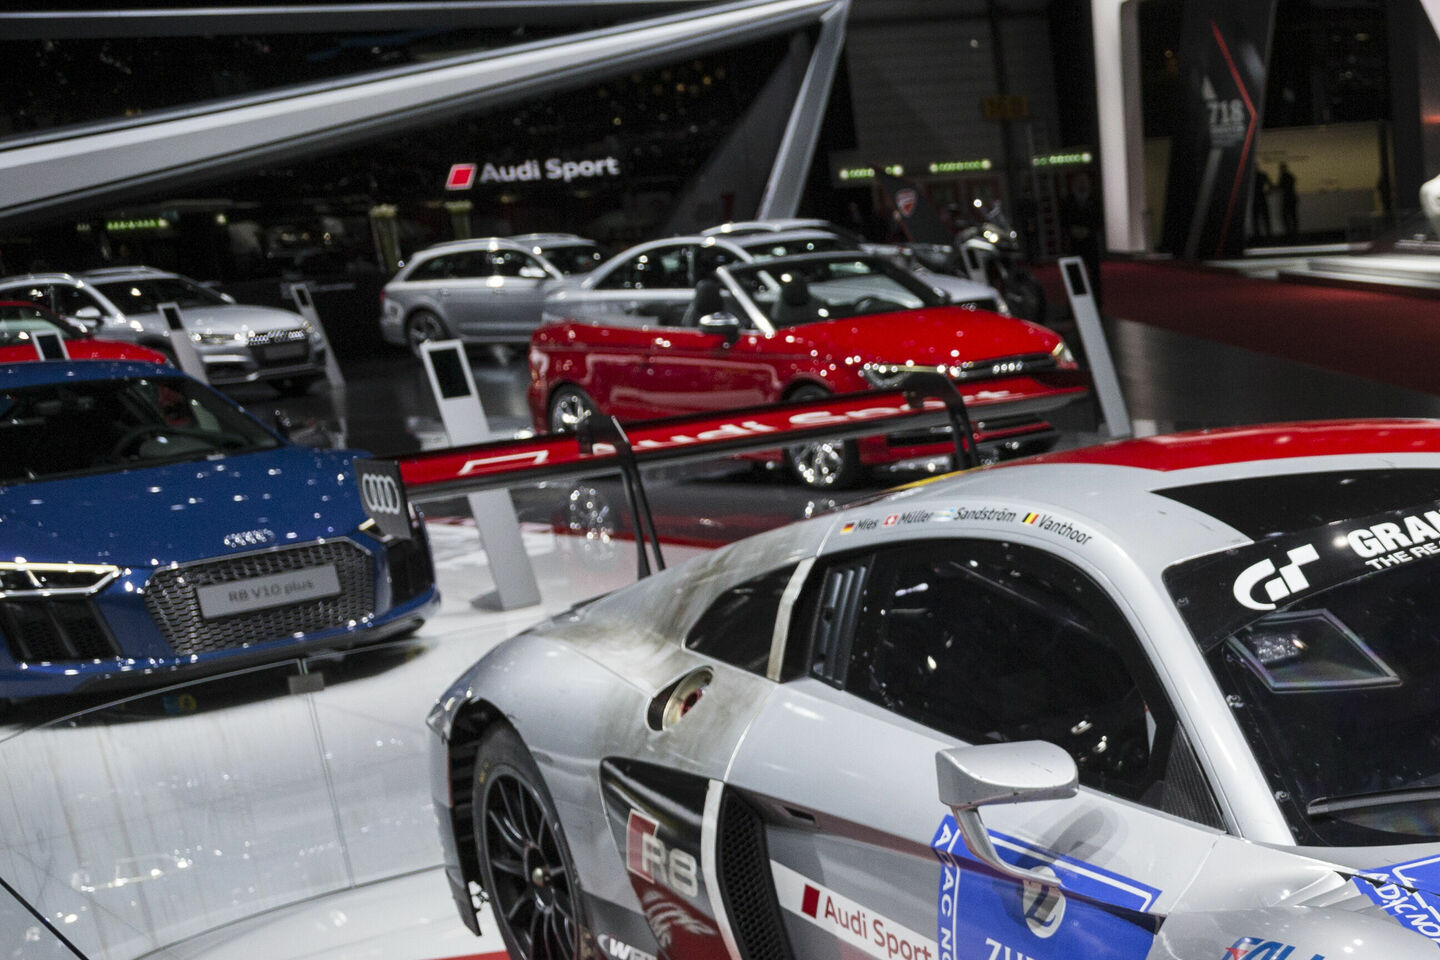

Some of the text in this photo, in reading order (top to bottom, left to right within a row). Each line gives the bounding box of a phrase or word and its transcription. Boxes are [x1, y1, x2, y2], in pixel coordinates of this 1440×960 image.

[480, 157, 620, 183] Audi Sport
[855, 519, 879, 532] Mies
[953, 507, 1016, 523] Sandström
[1037, 515, 1093, 546] Vanthoor
[1365, 551, 1411, 571] THE
[251, 583, 281, 599] V10
[641, 832, 698, 898] R8
[824, 895, 868, 939] Audi
